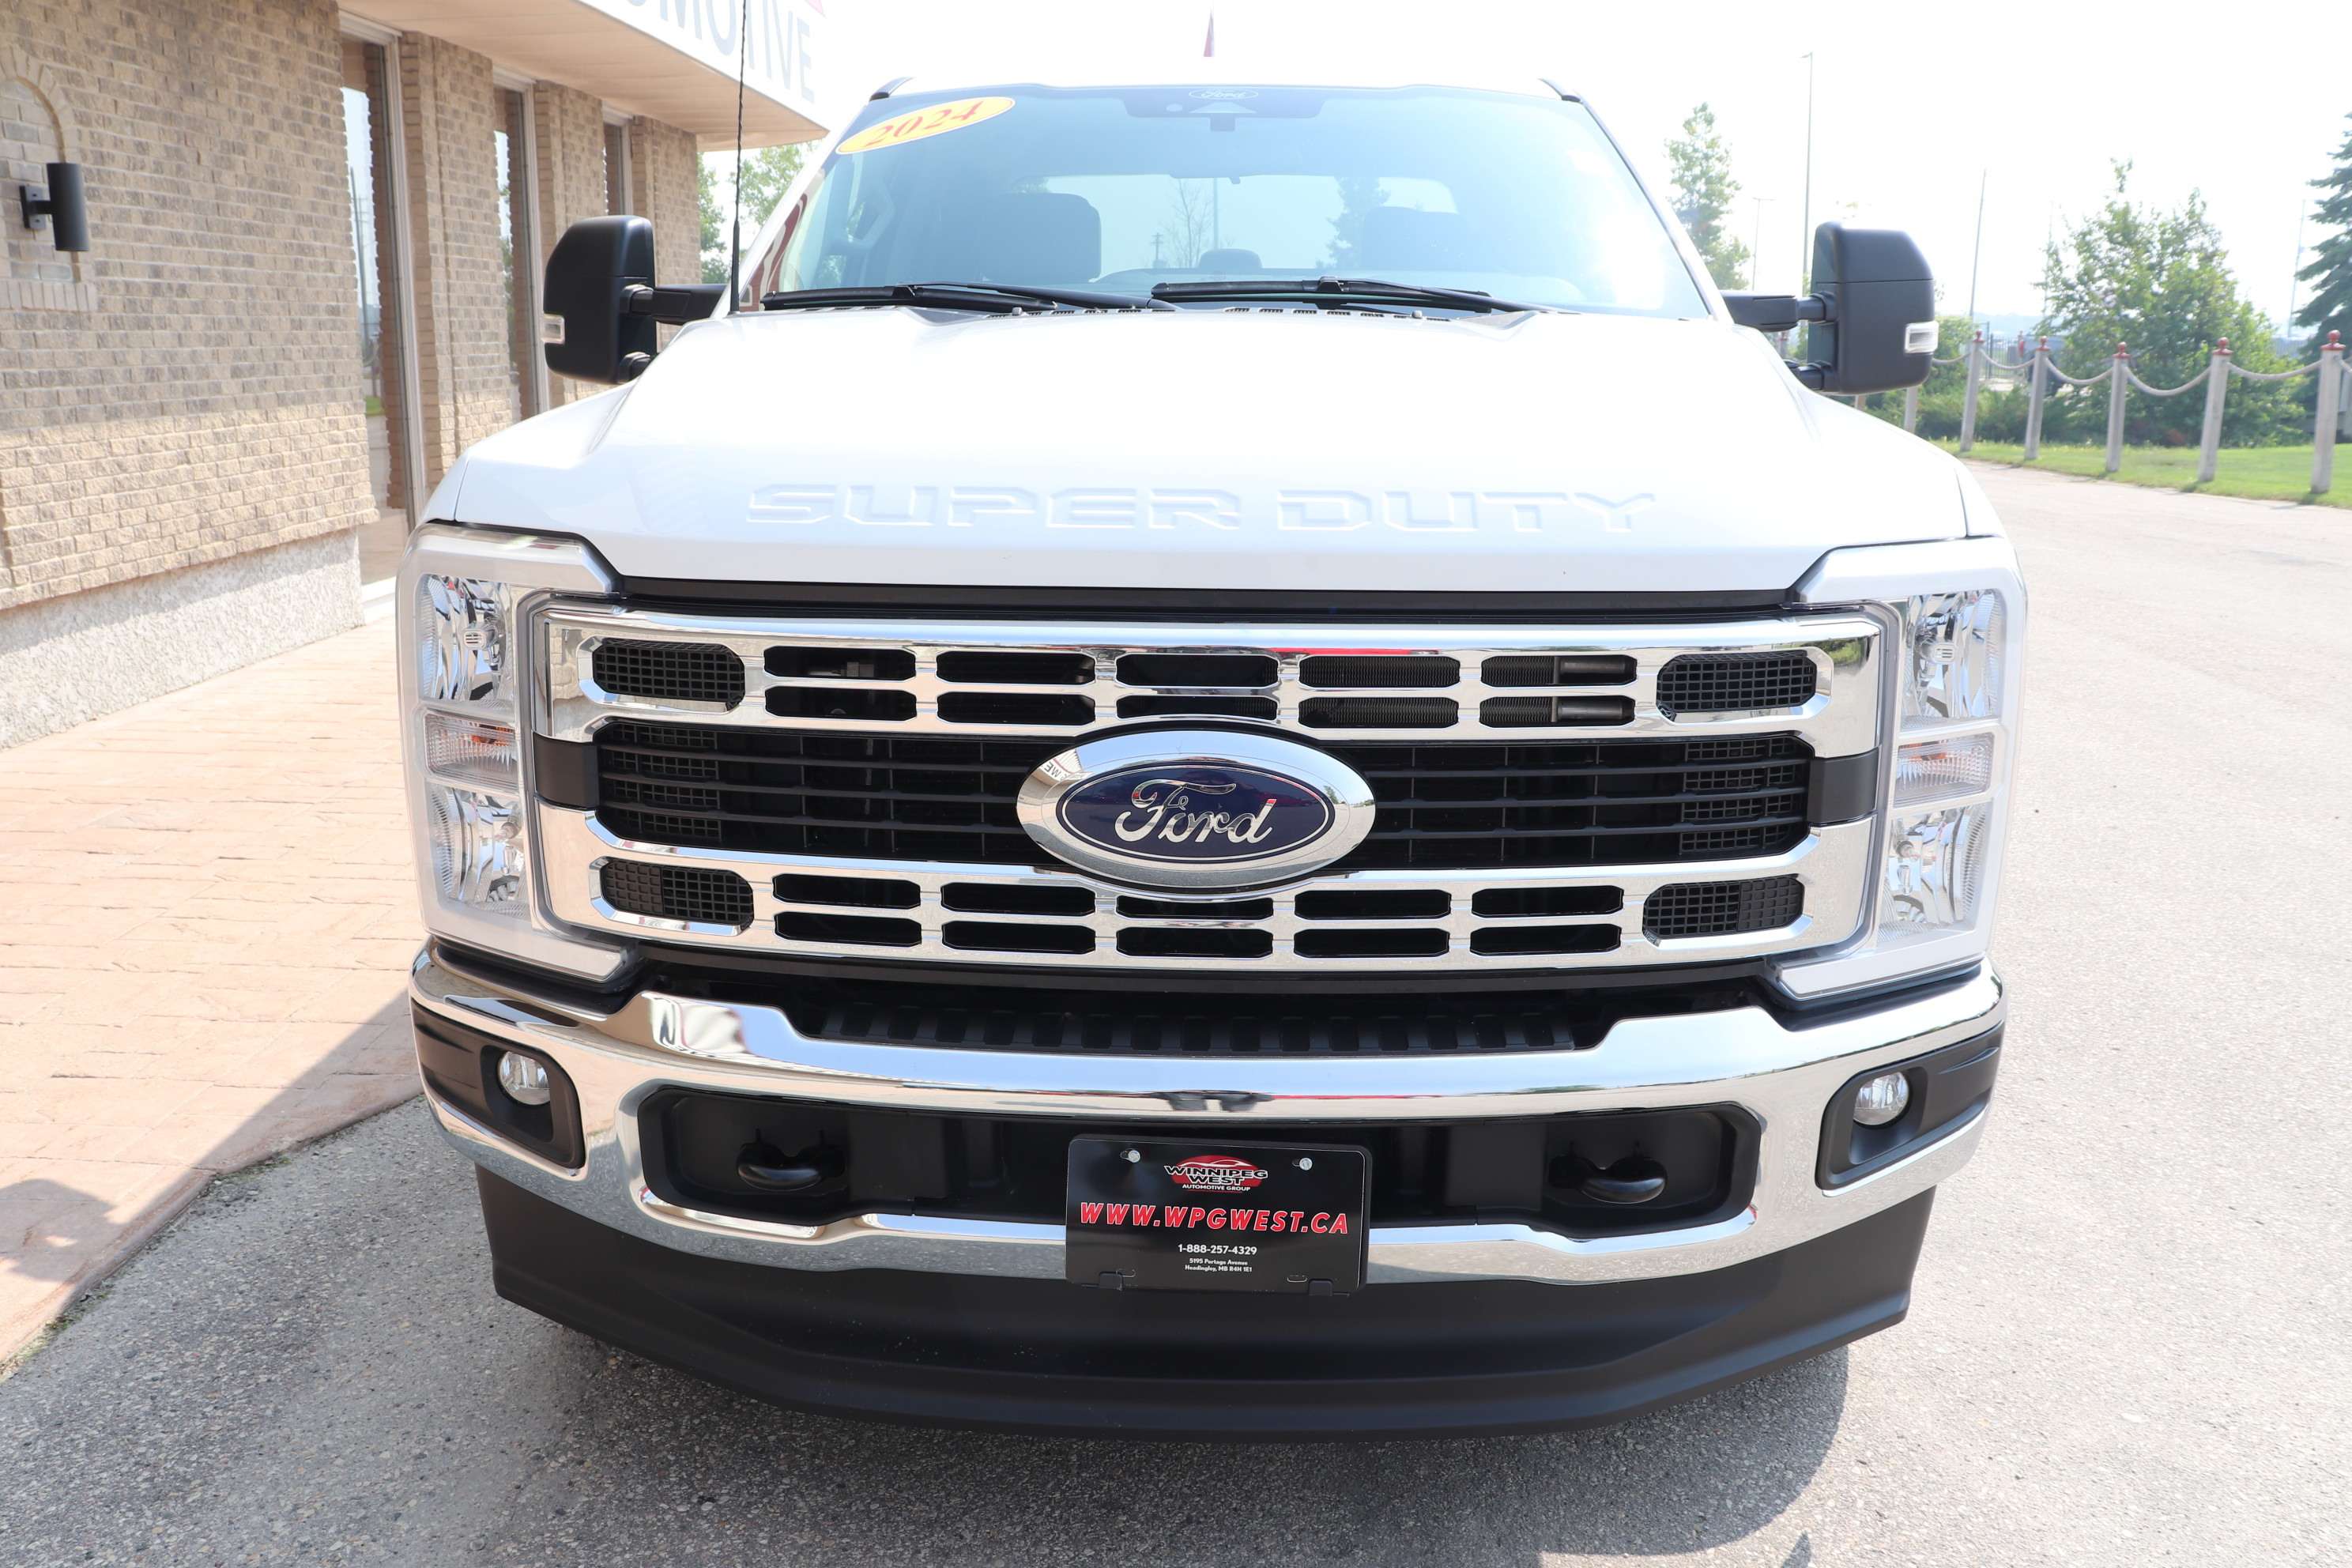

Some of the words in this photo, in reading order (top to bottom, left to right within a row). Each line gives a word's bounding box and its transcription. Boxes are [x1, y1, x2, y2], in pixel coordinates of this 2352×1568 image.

[863, 101, 983, 147] 2024
[746, 483, 1241, 530] SUPER
[1277, 489, 1657, 533] DUTY
[1114, 778, 1276, 843] Ford
[1164, 1165, 1268, 1179] WINNIPEG
[1188, 1174, 1245, 1186] WEST
[1081, 1202, 1348, 1234] WWW.WPGWEST.CA
[1178, 1244, 1257, 1255] 1-888-257-4329
[1185, 1264, 1218, 1272] Headingley,
